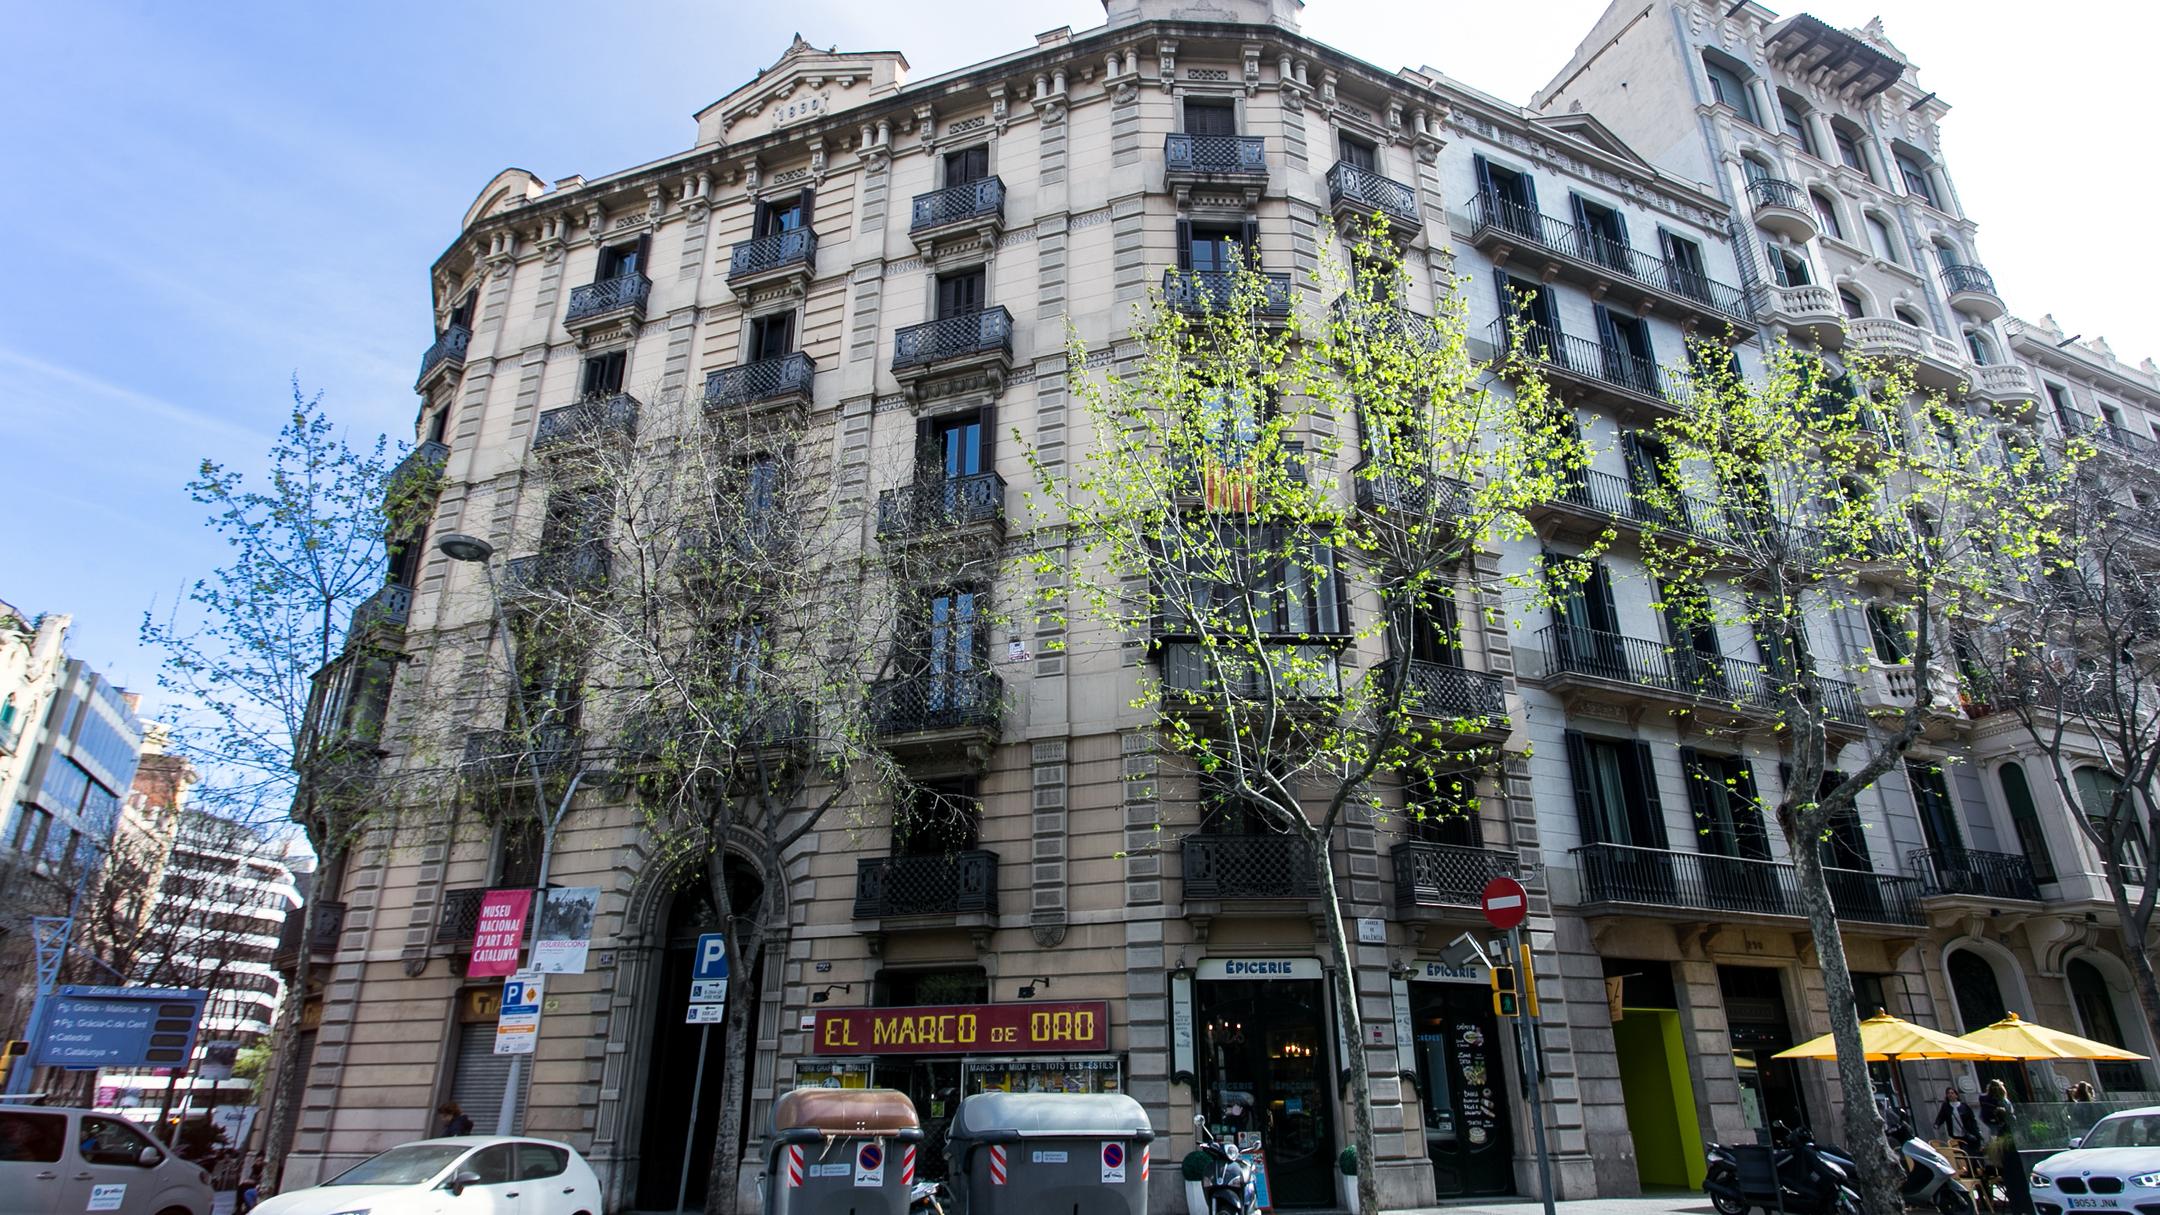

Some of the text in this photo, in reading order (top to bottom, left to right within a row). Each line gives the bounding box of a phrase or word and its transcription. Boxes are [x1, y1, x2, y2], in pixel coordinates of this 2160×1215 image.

[482, 905, 511, 918] MUSEU
[479, 919, 520, 932] NACIONAL
[476, 934, 515, 947] D'ART DE
[473, 948, 518, 963] CATALUNYA
[701, 939, 726, 974] P
[1226, 960, 1292, 974] ÉPICERIE
[507, 986, 519, 1004] P
[825, 1011, 1094, 1046] EL MARCO DE ORO
[970, 1064, 995, 1072] MARCS
[1069, 1062, 1084, 1070] ELS
